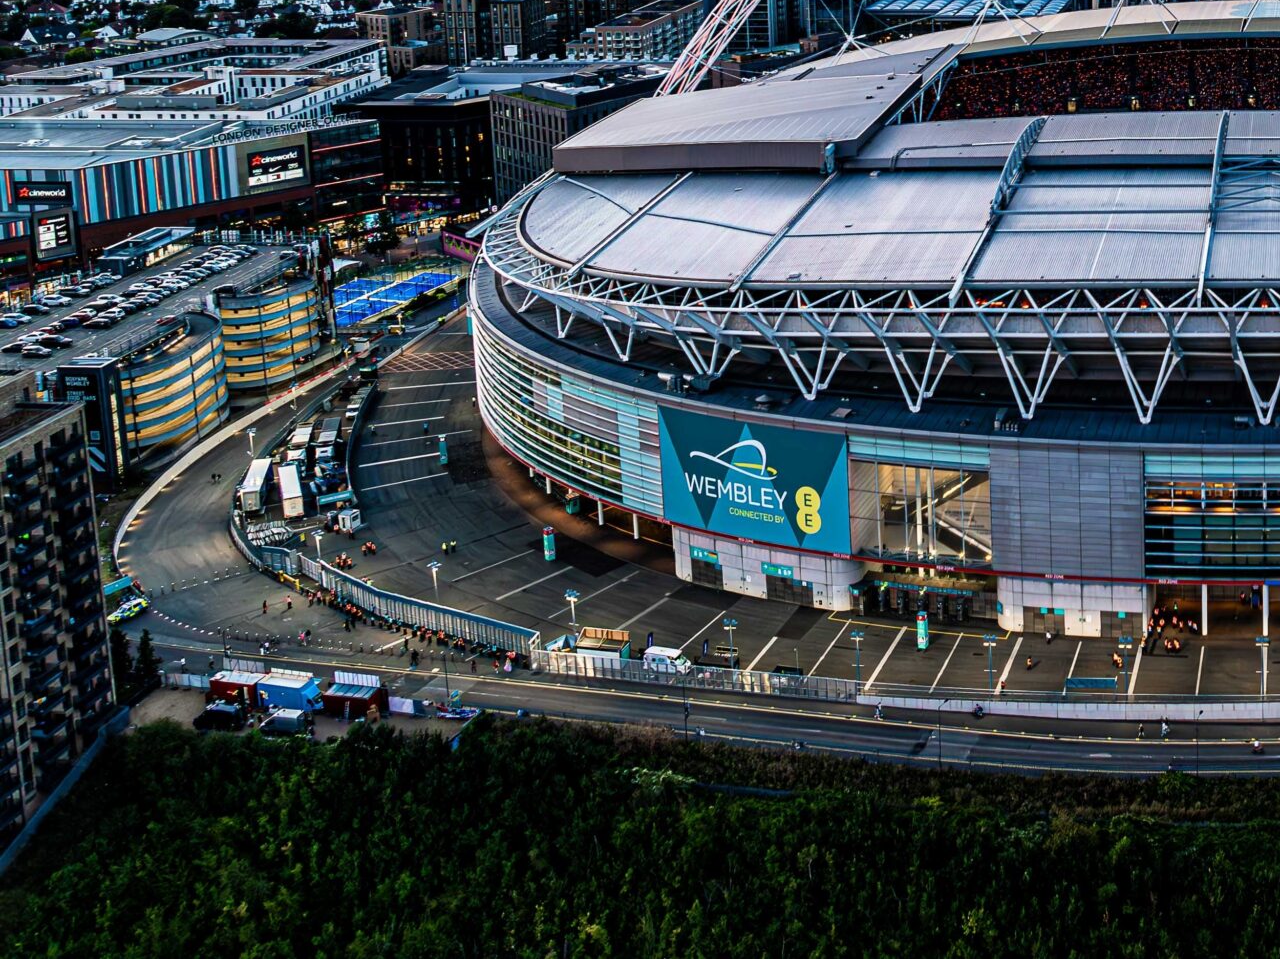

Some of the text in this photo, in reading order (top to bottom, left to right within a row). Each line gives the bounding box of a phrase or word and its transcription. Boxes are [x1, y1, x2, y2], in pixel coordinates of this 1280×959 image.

[212, 127, 261, 142] LONDON
[265, 118, 319, 134] DESIGNER
[261, 151, 298, 163] cineworld
[29, 188, 66, 197] cineworld
[684, 472, 788, 510] WEMBLEY
[729, 507, 785, 524] CONNECTED BY
